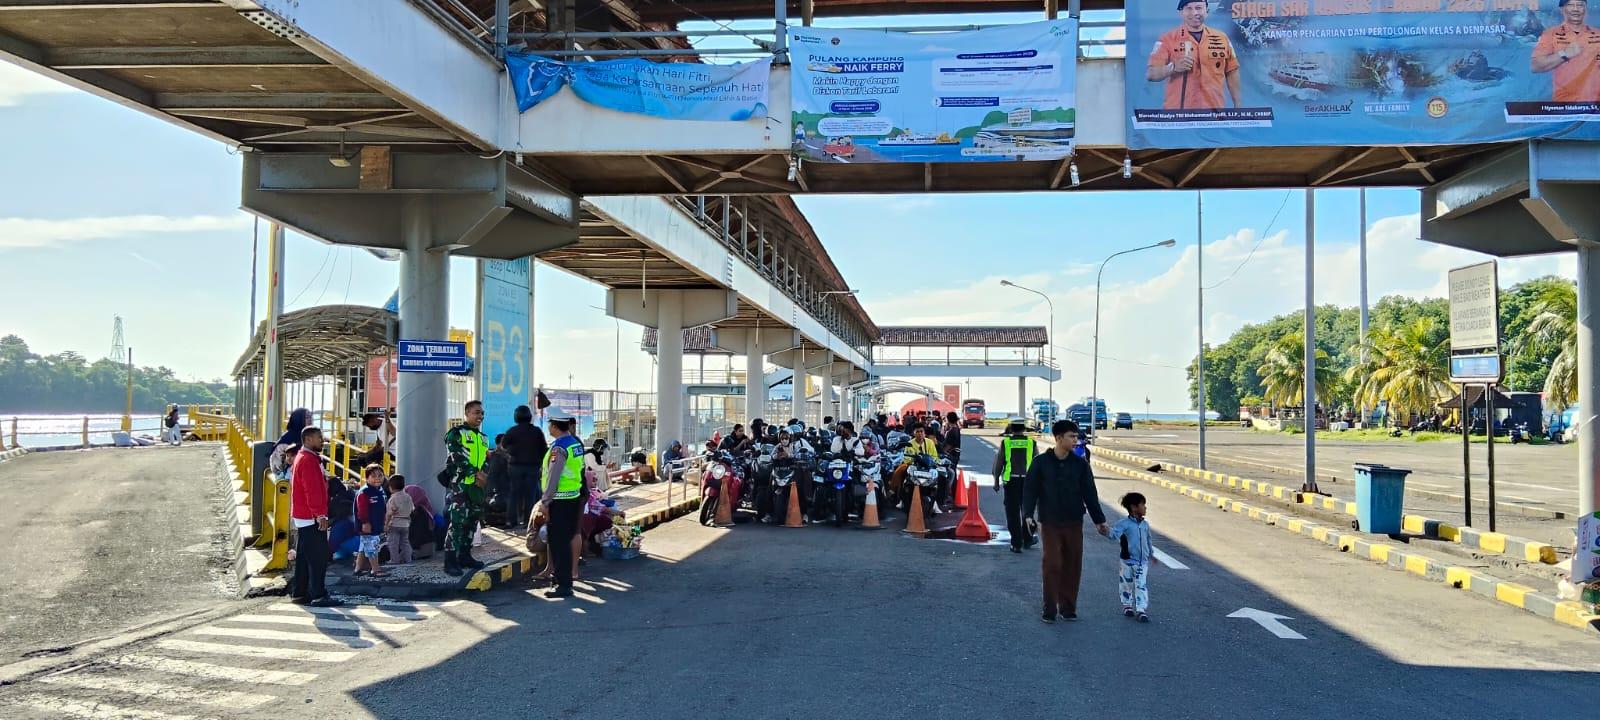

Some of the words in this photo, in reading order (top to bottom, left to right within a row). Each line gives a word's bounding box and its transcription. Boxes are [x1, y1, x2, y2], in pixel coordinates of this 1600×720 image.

[1265, 30, 1298, 39] KANTOR
[1300, 28, 1346, 38] PENCARIAN
[1348, 28, 1366, 36] DAN
[1368, 26, 1428, 36] PERTOLONGAN
[1429, 26, 1453, 35] KELAS
[1456, 26, 1461, 34] A
[1463, 25, 1506, 34] DENPASAR
[809, 54, 849, 62] PULANG
[844, 64, 868, 72] NAIK
[870, 63, 903, 71] FERRY
[663, 68, 685, 79] Hari
[689, 71, 713, 84] Fitri,
[813, 77, 838, 85] Makin
[840, 77, 866, 87] Happy
[867, 77, 898, 86] dengan
[690, 83, 739, 94] Sepenuh
[742, 82, 765, 92] Hati
[813, 87, 841, 95] Diskon
[843, 87, 862, 95] Tarif
[407, 344, 425, 353] ZONA
[426, 345, 459, 354] TERBATAS
[487, 319, 525, 395] B3
[402, 359, 424, 367] KHUSUS
